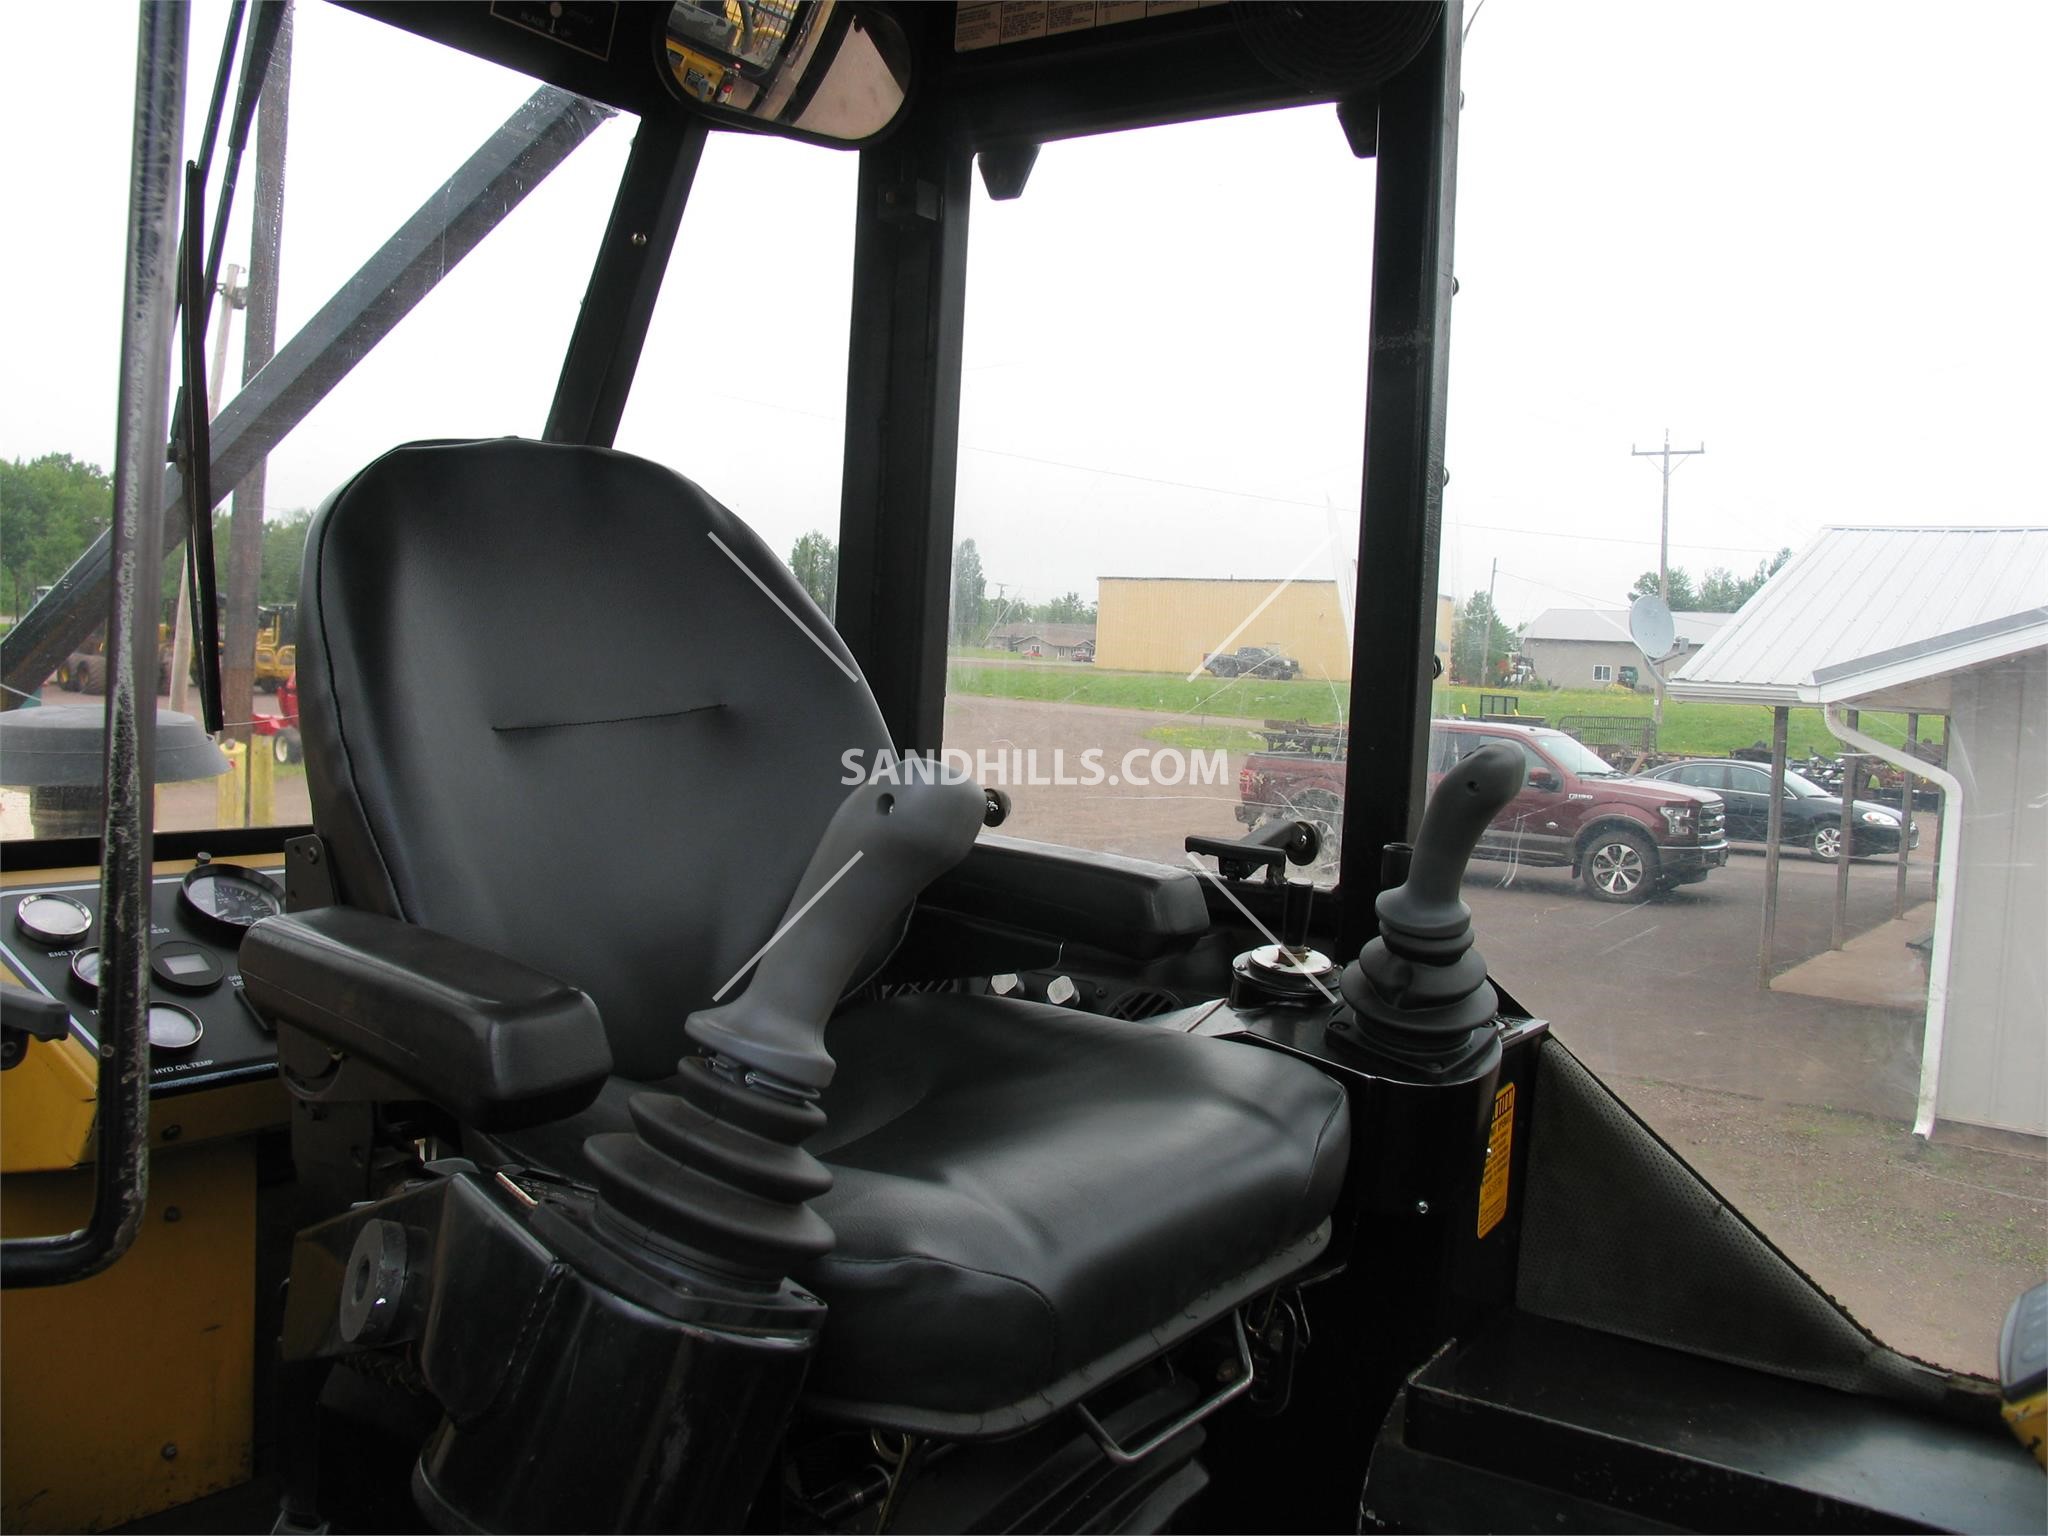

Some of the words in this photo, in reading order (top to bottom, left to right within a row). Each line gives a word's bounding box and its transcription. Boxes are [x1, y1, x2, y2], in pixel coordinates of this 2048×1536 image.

[154, 1066, 174, 1074] HYD
[175, 1063, 191, 1071] OIL
[190, 1059, 214, 1068] TEMP
